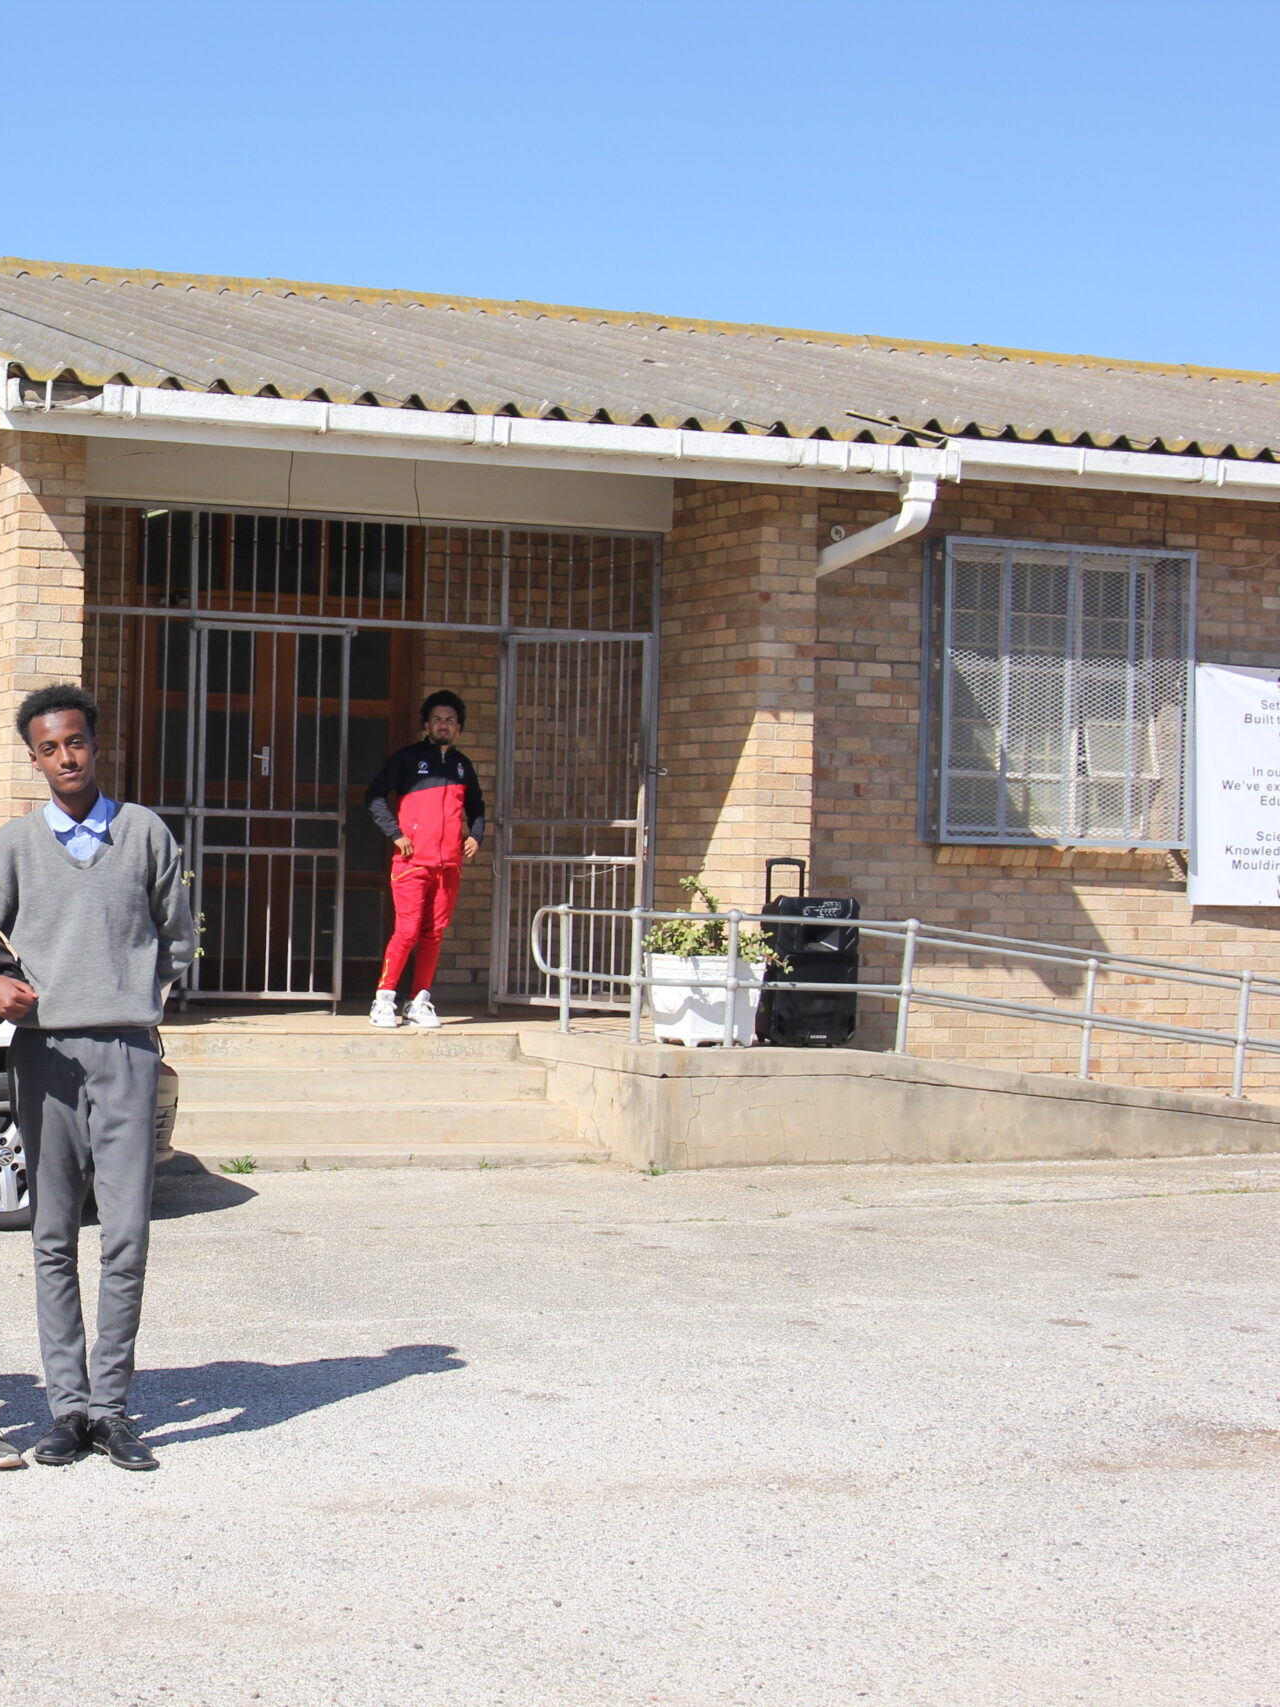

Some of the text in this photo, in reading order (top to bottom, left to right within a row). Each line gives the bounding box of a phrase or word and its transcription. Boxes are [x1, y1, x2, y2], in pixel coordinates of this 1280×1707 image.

[1244, 713, 1274, 724] Built
[1252, 766, 1263, 776] In
[1222, 780, 1260, 791] We've
